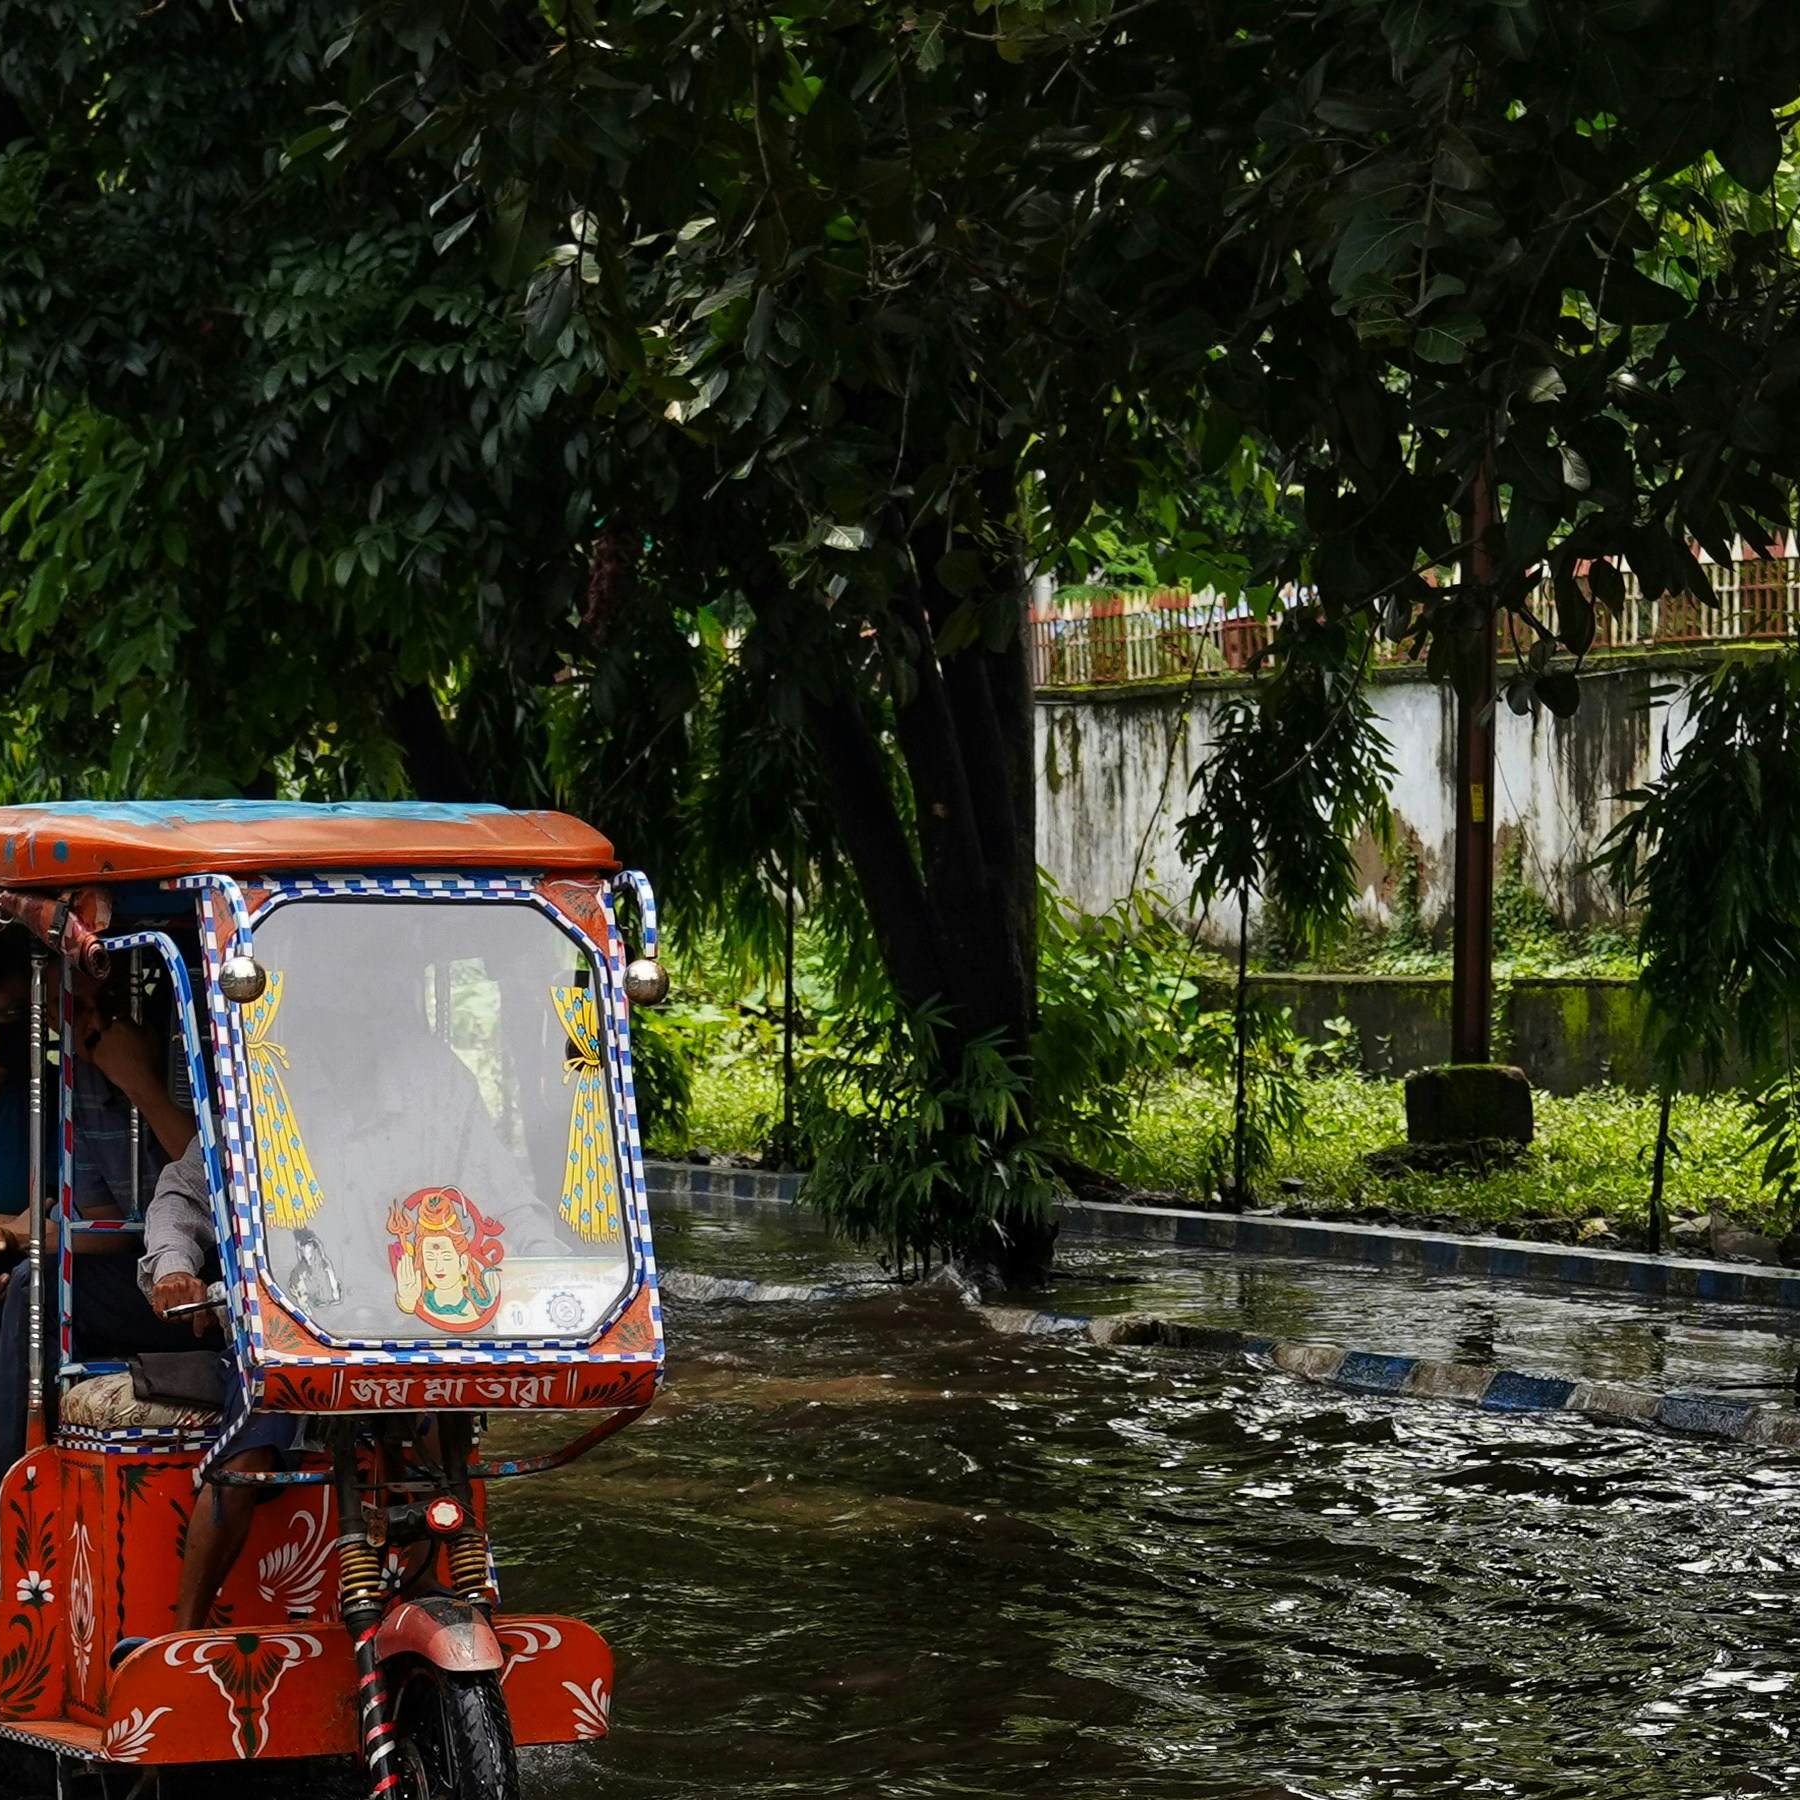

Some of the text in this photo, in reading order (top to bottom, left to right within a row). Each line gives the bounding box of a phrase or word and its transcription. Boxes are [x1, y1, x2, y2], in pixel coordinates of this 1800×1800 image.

[350, 1378, 421, 1408] জয়
[423, 1378, 473, 1403] মা
[475, 1375, 559, 1407] তারা
